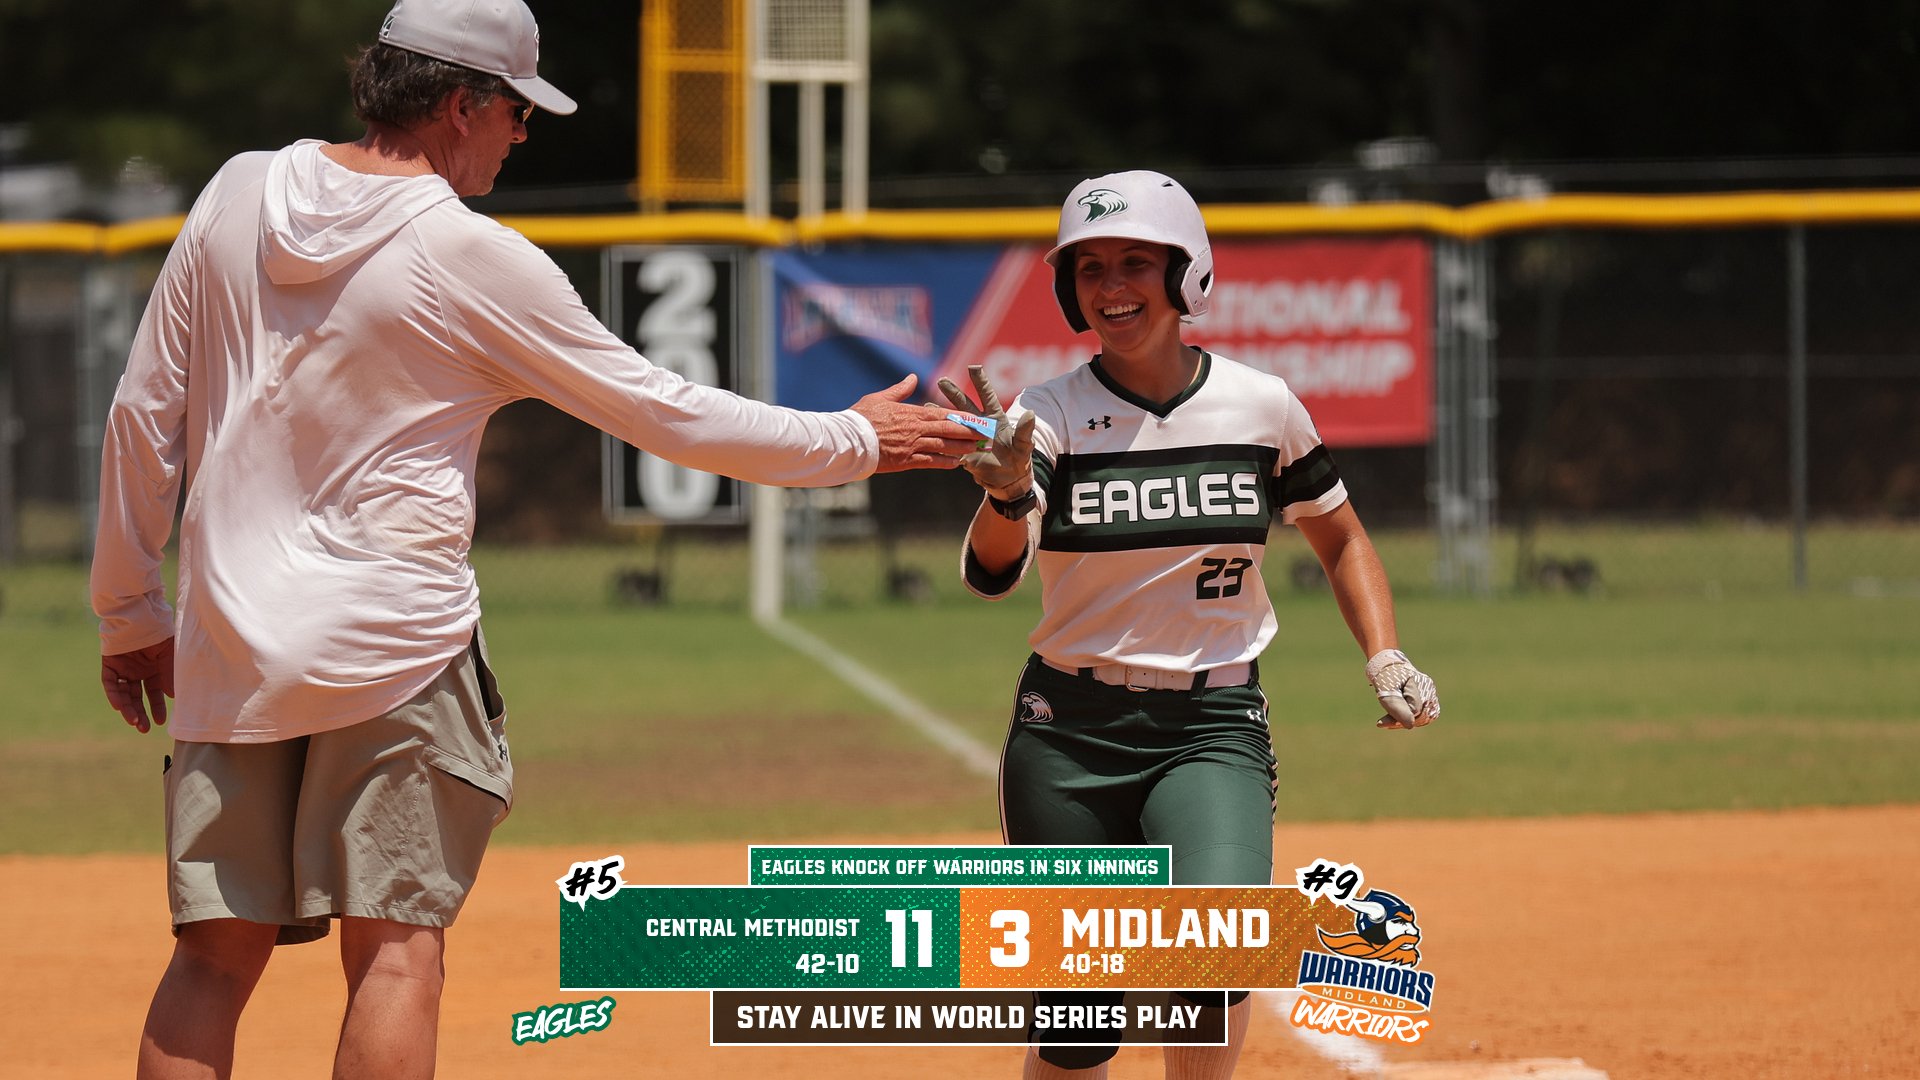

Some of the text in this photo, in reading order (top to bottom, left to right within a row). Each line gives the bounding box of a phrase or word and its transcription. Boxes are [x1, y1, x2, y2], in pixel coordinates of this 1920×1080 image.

[1192, 281, 1412, 337] TIONAL
[961, 415, 988, 427] HARIB
[1070, 472, 1260, 525] EAGLES
[1195, 557, 1253, 600] 23
